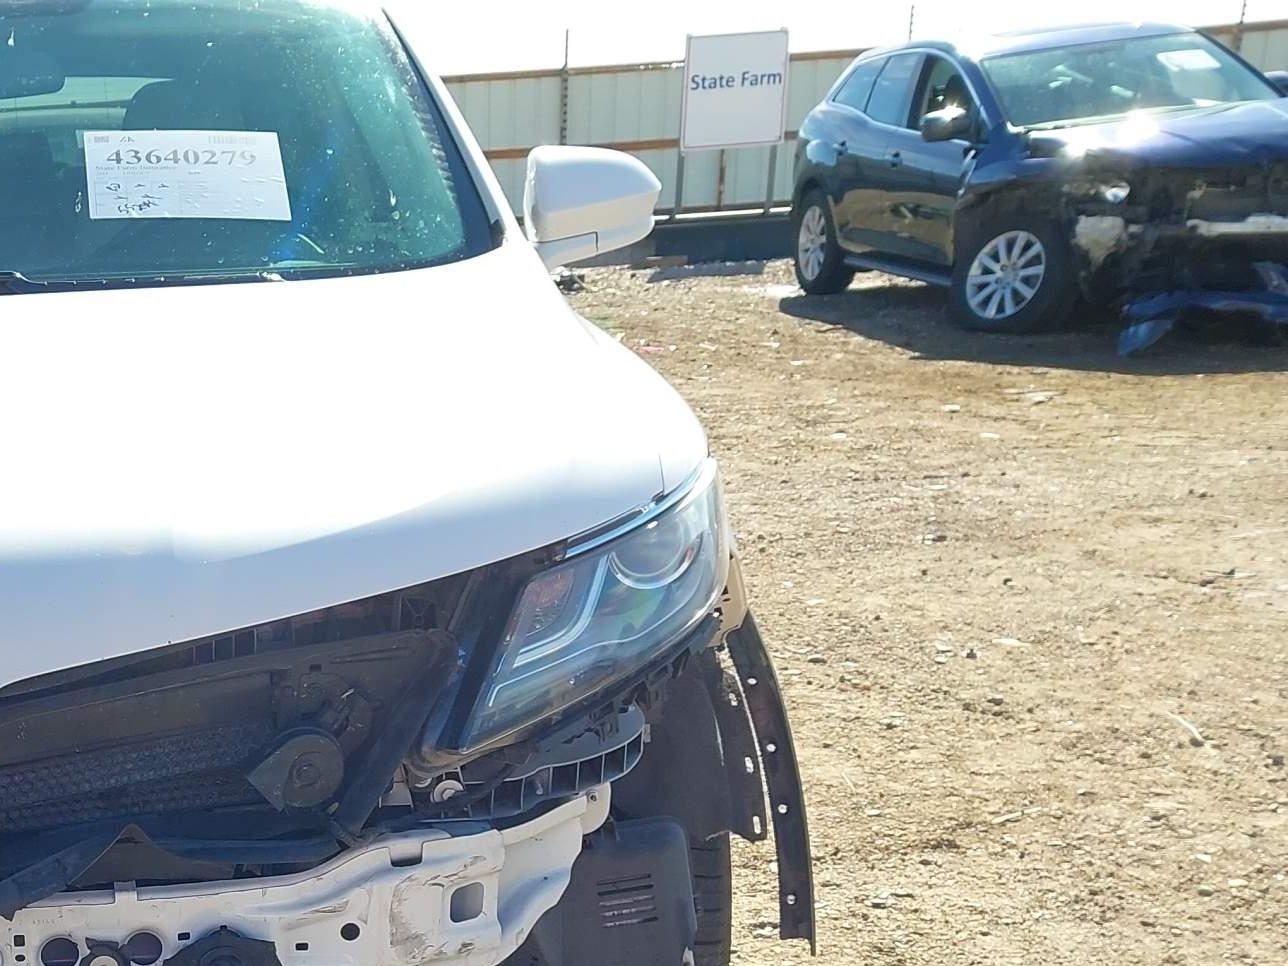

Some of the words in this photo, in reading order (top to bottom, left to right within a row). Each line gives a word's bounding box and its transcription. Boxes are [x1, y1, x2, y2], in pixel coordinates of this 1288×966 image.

[690, 74, 735, 90] State
[741, 71, 782, 86] Farm
[106, 148, 257, 166] 43640279
